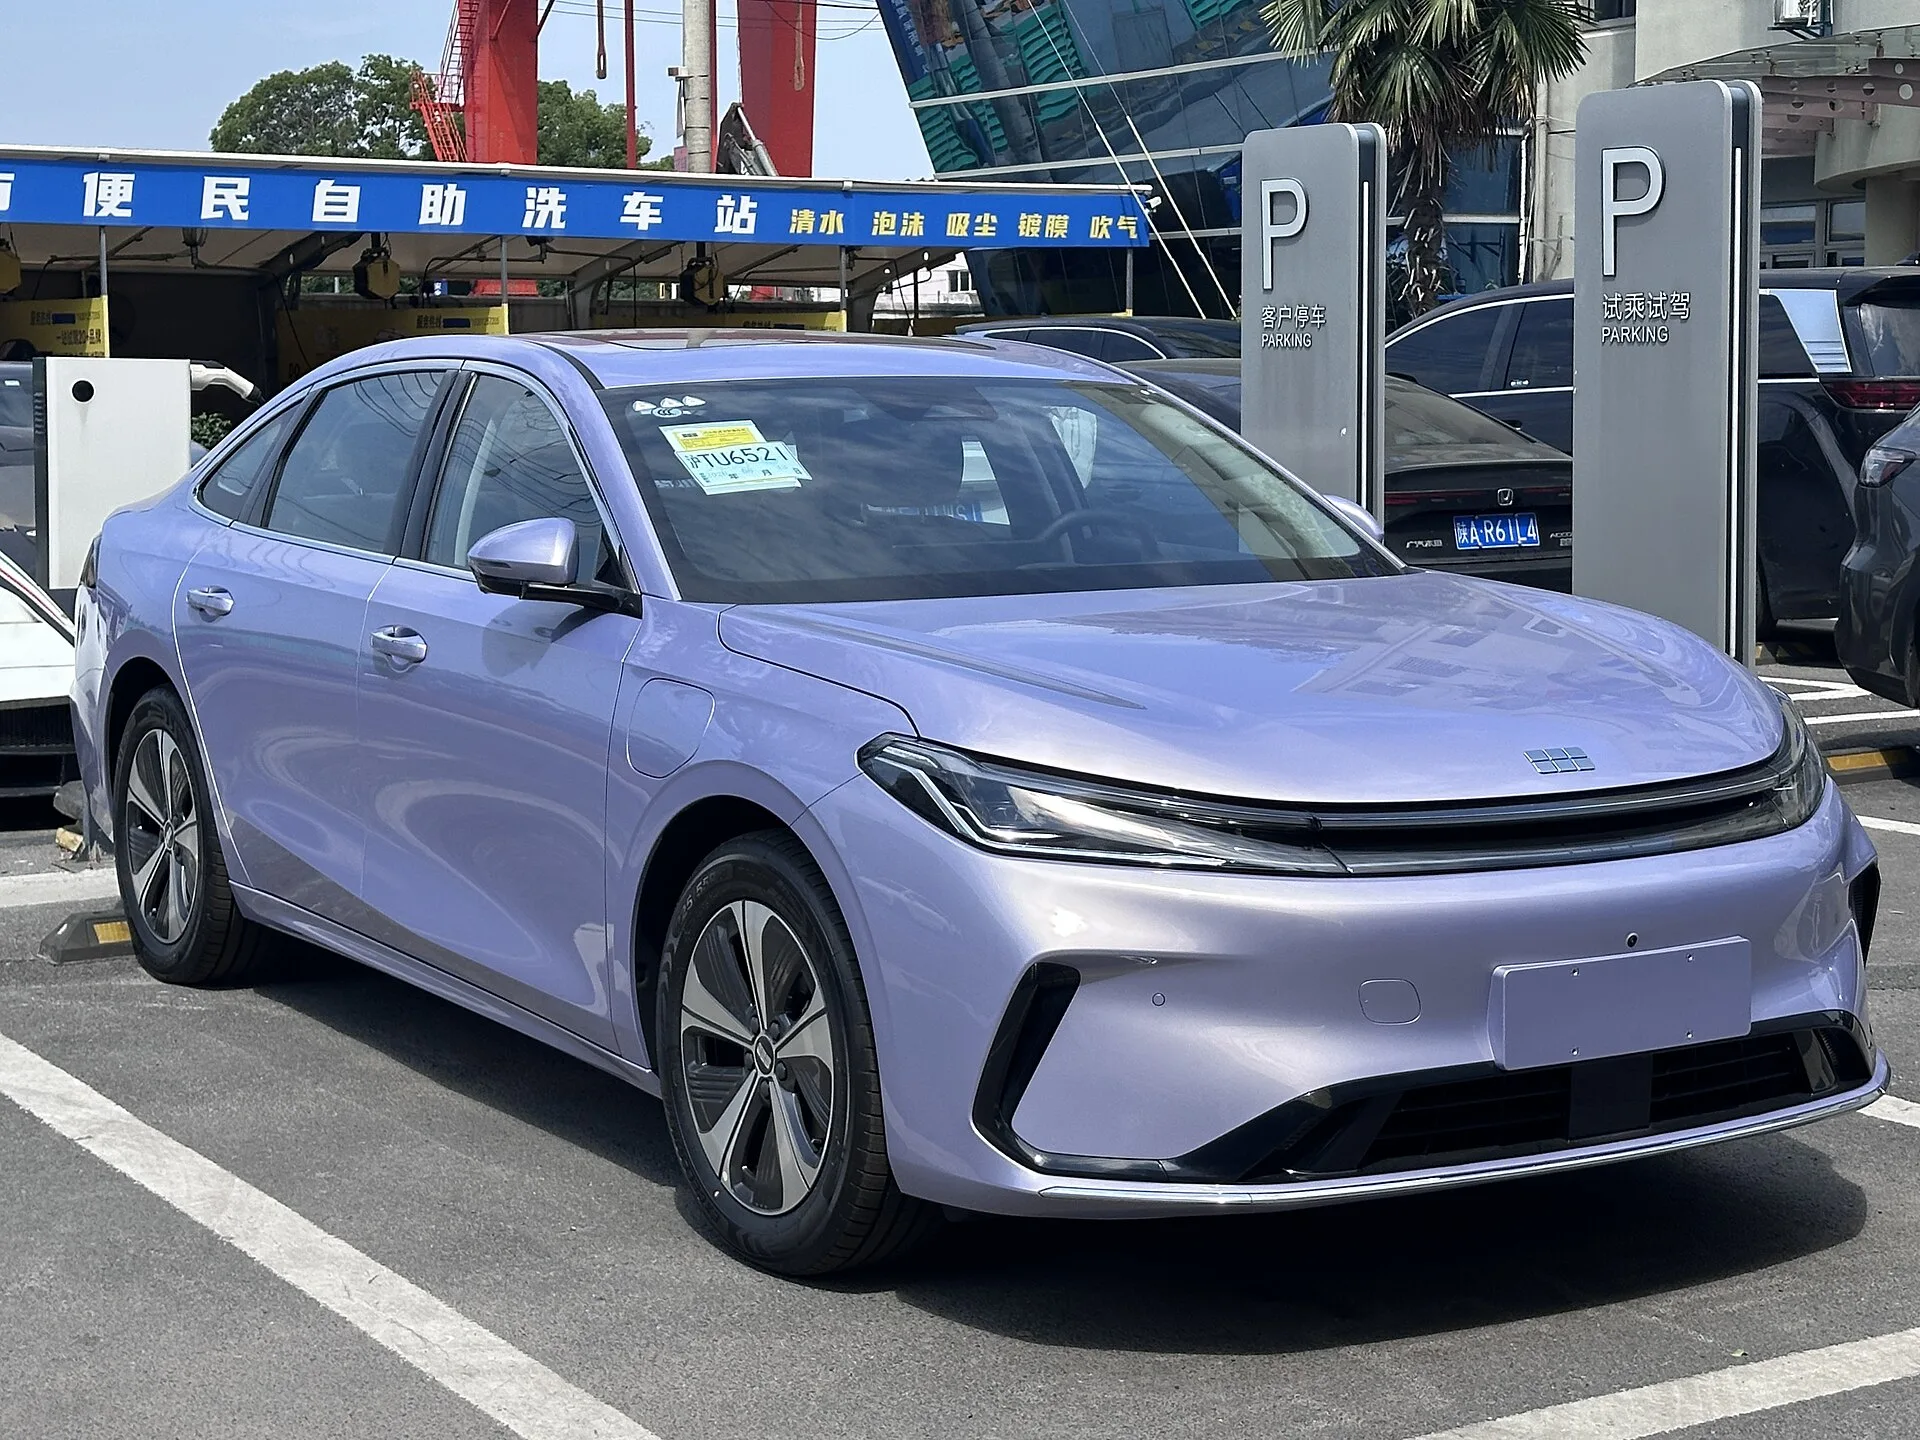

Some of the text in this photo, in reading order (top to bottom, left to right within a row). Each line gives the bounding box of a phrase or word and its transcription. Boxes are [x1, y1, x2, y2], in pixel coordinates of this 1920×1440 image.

[0, 172, 1138, 239] 便民自助洗车站 清水 泡沫 吸尘 镀膜 吹气
[1601, 146, 1664, 276] P
[1261, 178, 1307, 289] P
[1261, 304, 1326, 329] 客户停车
[1603, 291, 1690, 320] 试乘试驾
[1261, 333, 1311, 348] PARKING
[1602, 326, 1668, 342] PARKING
